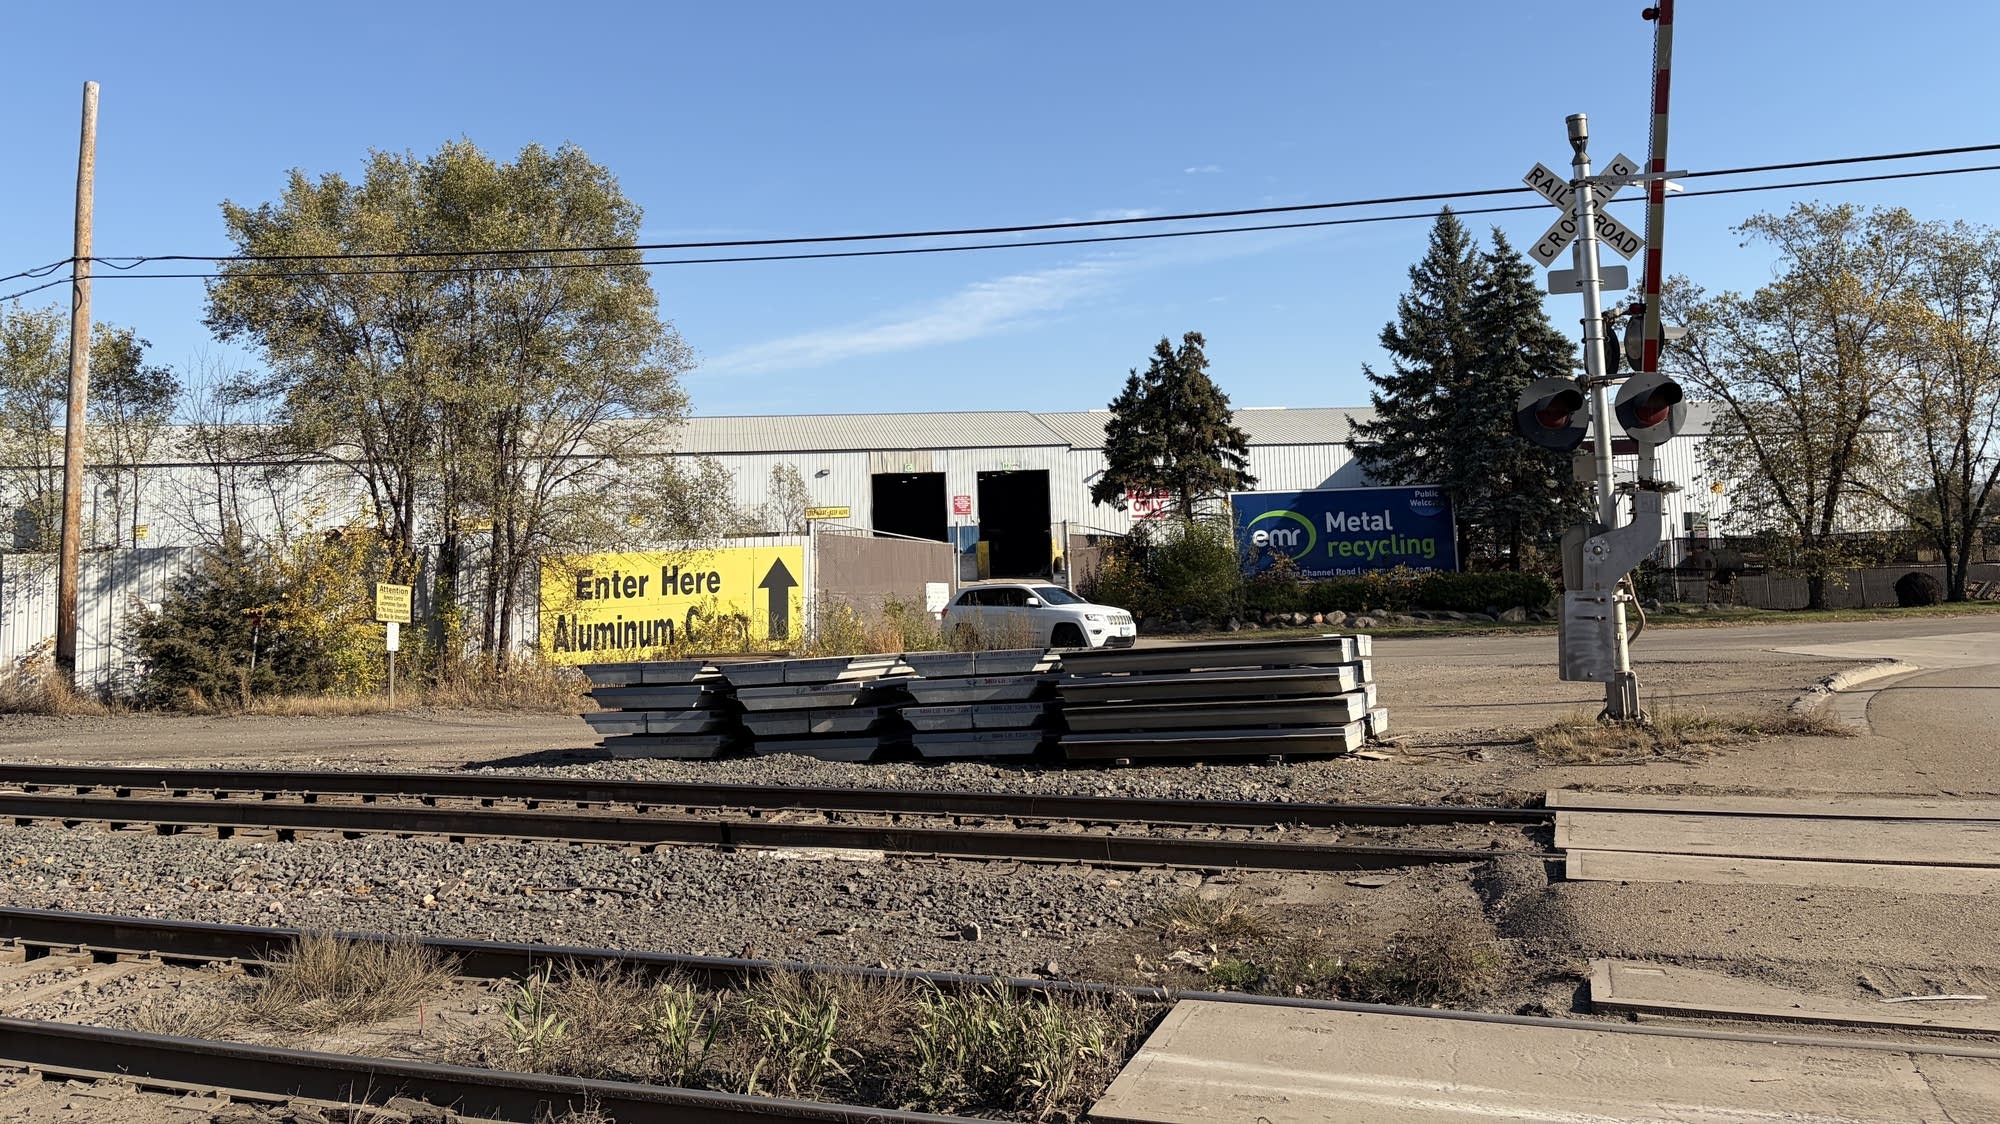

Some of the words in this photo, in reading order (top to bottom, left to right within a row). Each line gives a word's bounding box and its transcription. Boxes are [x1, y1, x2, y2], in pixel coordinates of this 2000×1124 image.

[1527, 167, 1568, 206] RAIL
[1414, 490, 1439, 498] Public
[1325, 509, 1394, 534] Metal
[1252, 527, 1301, 548] emr
[1327, 534, 1436, 562] recycling
[576, 569, 649, 600] Enter
[661, 565, 721, 596] Here
[1302, 567, 1335, 578] Channel
[1336, 567, 1356, 577] Road
[379, 585, 409, 595] Attention
[553, 613, 675, 653] Aluminum
